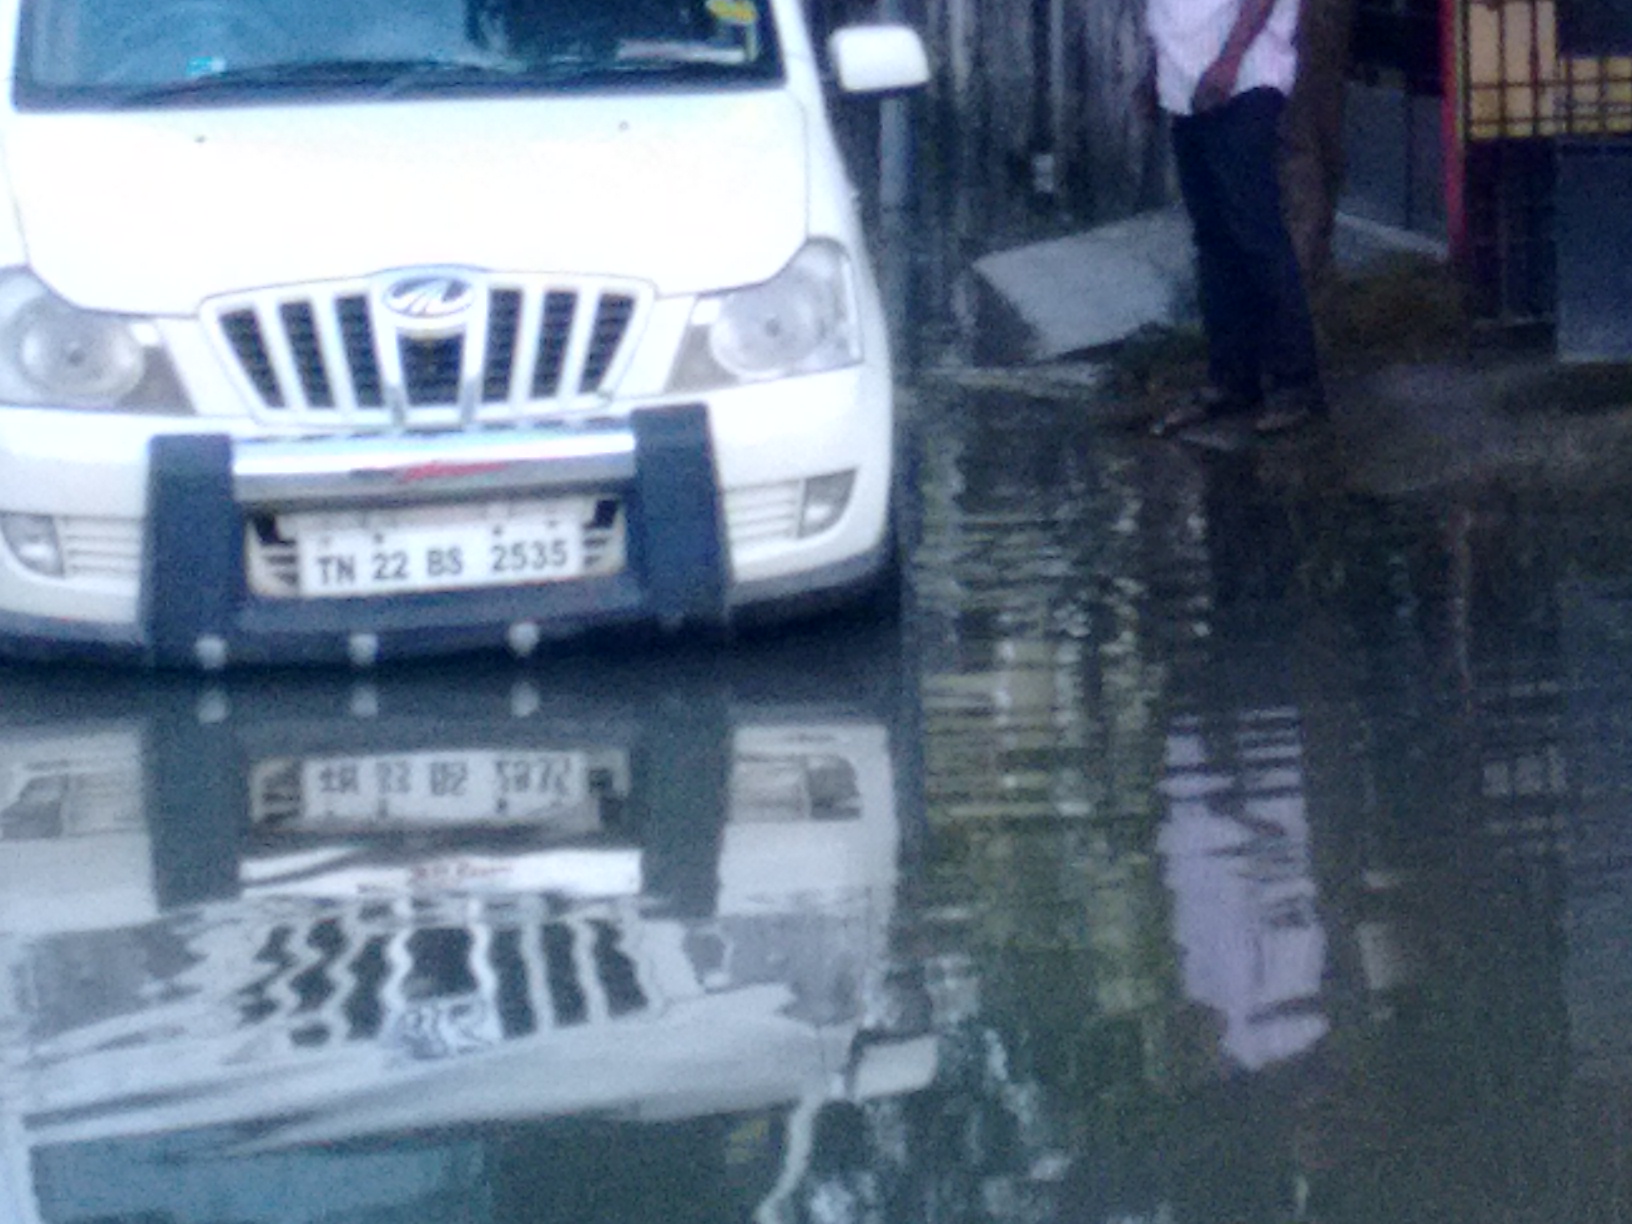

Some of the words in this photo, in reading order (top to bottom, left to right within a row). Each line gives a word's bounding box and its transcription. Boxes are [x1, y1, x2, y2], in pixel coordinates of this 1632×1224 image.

[316, 555, 357, 584] TN
[373, 551, 409, 580] 22
[427, 547, 463, 575] BS
[491, 540, 569, 572] 2535
